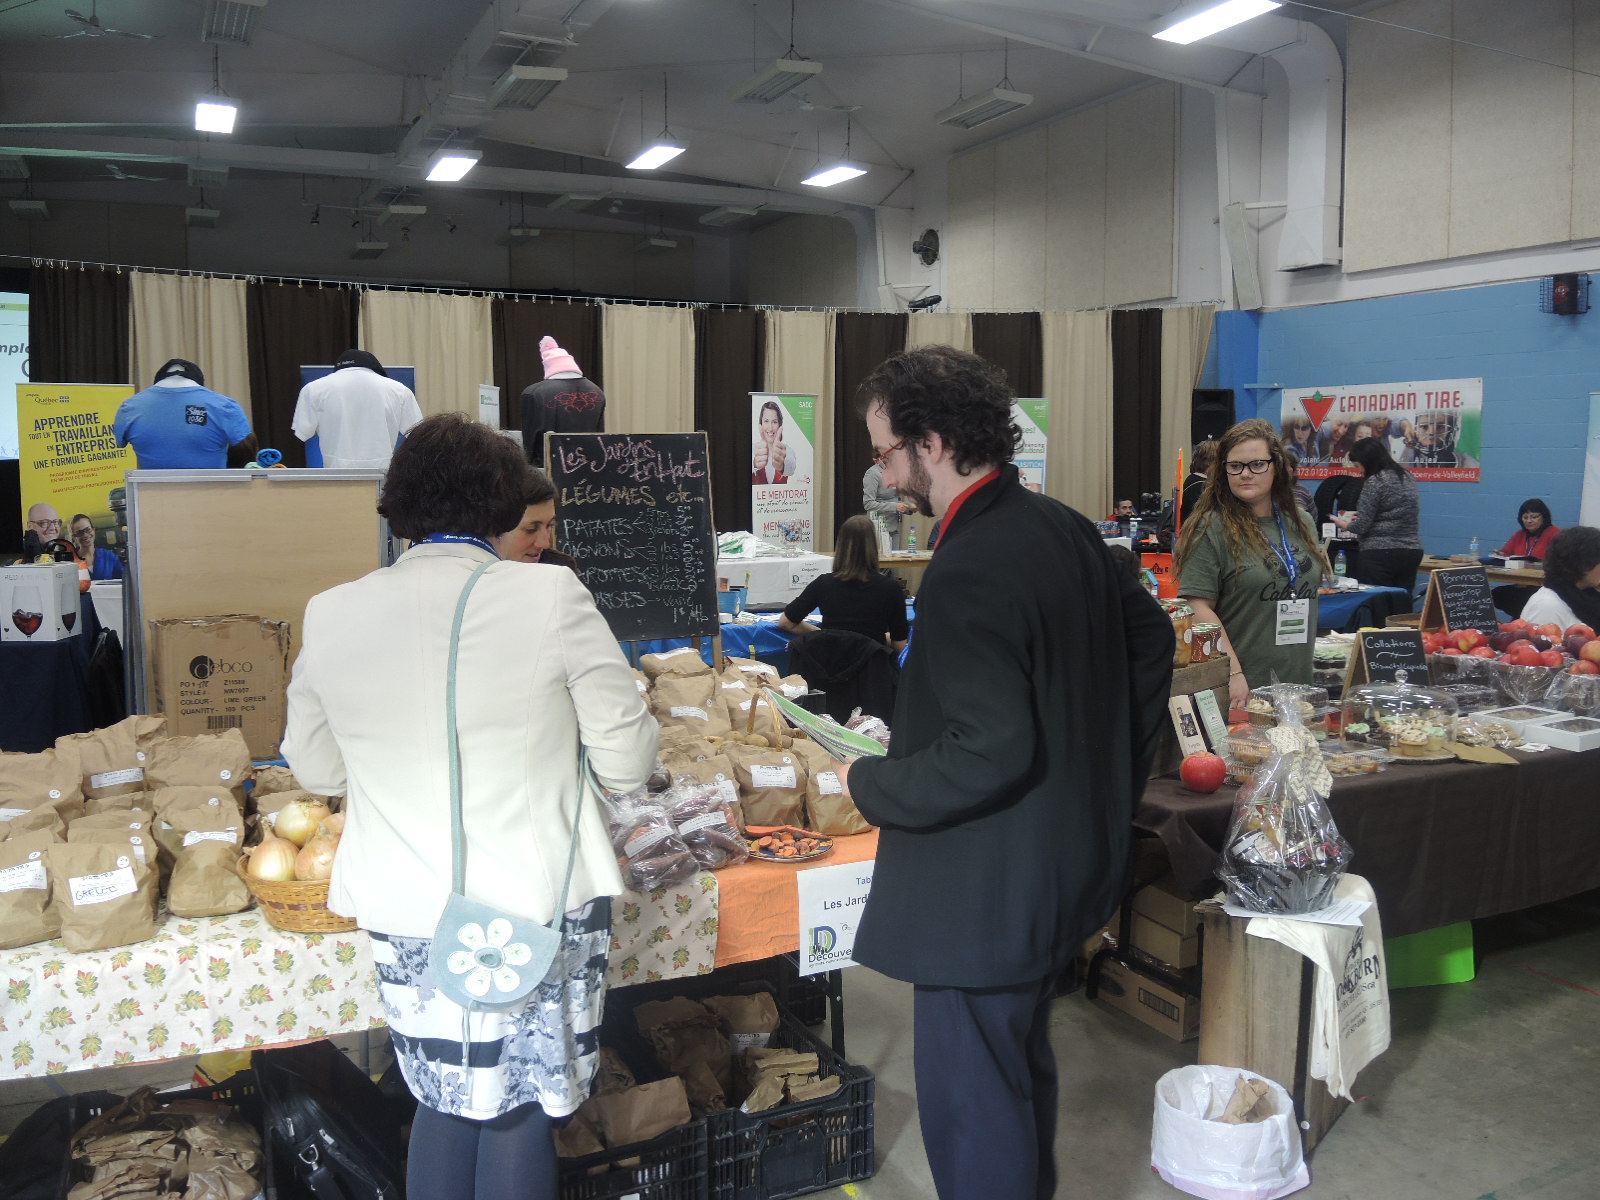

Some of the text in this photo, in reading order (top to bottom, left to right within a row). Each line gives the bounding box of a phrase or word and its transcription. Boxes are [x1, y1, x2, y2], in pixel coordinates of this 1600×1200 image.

[1339, 390, 1461, 413] CANADIAN TIRE
[34, 412, 101, 431] APPRENDRE
[53, 424, 116, 443] TRAVAILLAN
[33, 459, 49, 470] UNE
[50, 455, 86, 468] FORMULE
[559, 436, 656, 474] Les Jardins
[561, 478, 657, 507] LÉGUMES
[756, 489, 808, 500] LE MENTORAT
[563, 517, 634, 540] PATATES
[1439, 571, 1486, 584] Pommes
[1364, 636, 1417, 649] Collations
[194, 655, 253, 679] debco
[243, 695, 267, 703] GREEN
[856, 876, 873, 885] Tab
[823, 900, 842, 910] Les
